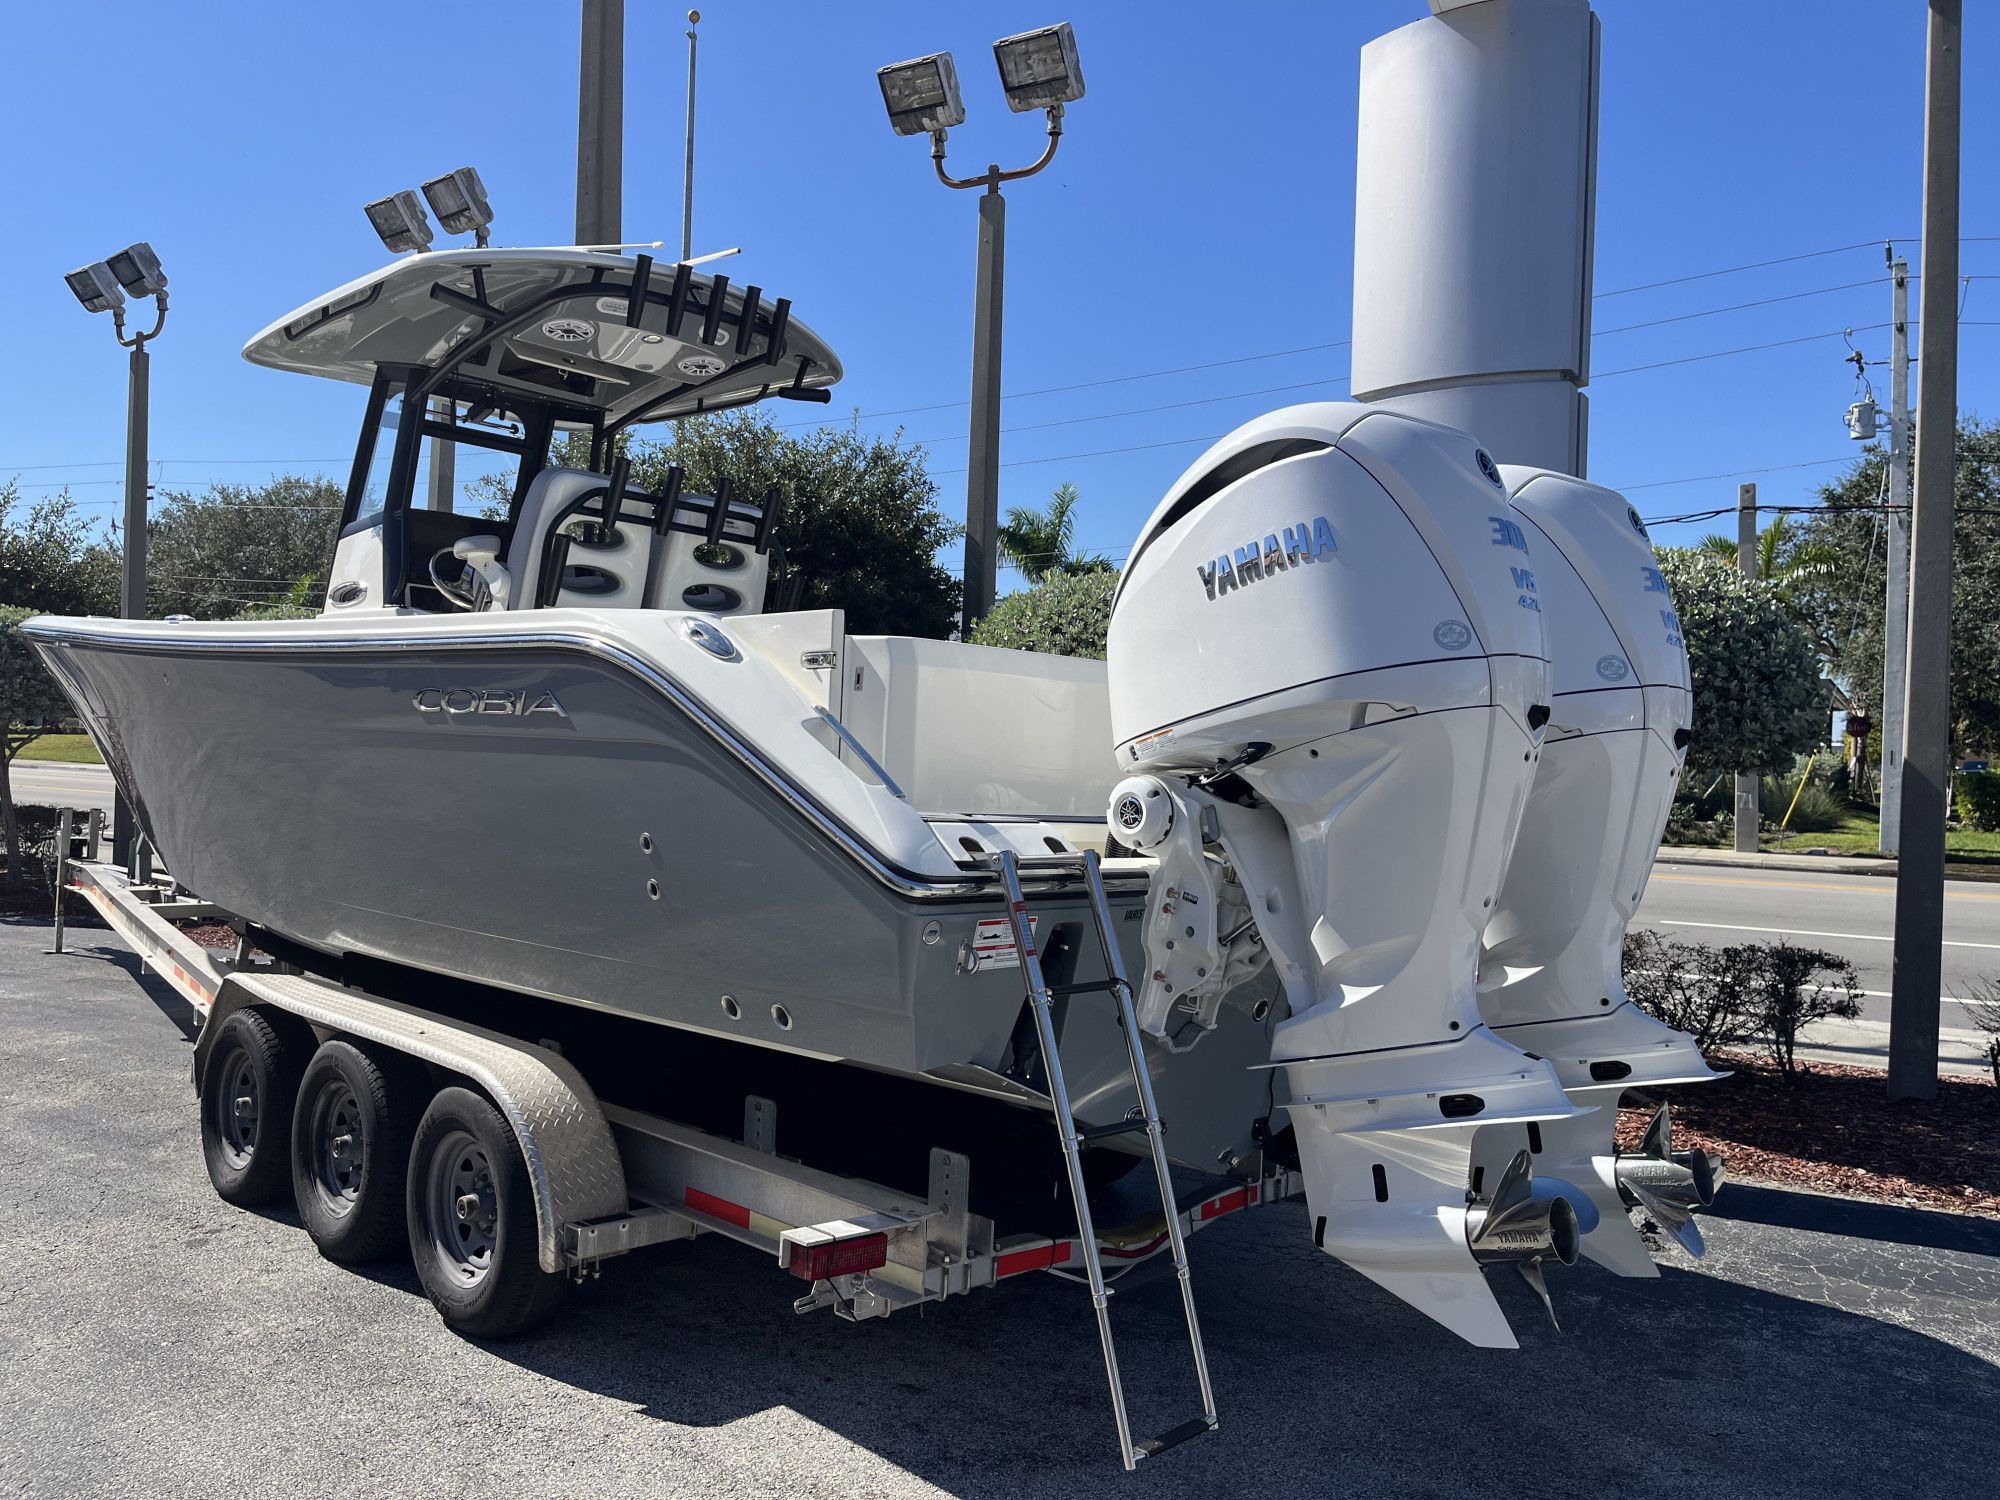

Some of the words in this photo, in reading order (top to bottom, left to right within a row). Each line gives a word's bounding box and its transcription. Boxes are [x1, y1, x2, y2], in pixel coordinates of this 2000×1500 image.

[1197, 516, 1338, 601] YAMAHA
[1510, 567, 1537, 593] V6
[412, 687, 568, 718] COBIA
[1632, 1165, 1670, 1177] YAMAHA
[1497, 1230, 1541, 1244] YAMAHA
